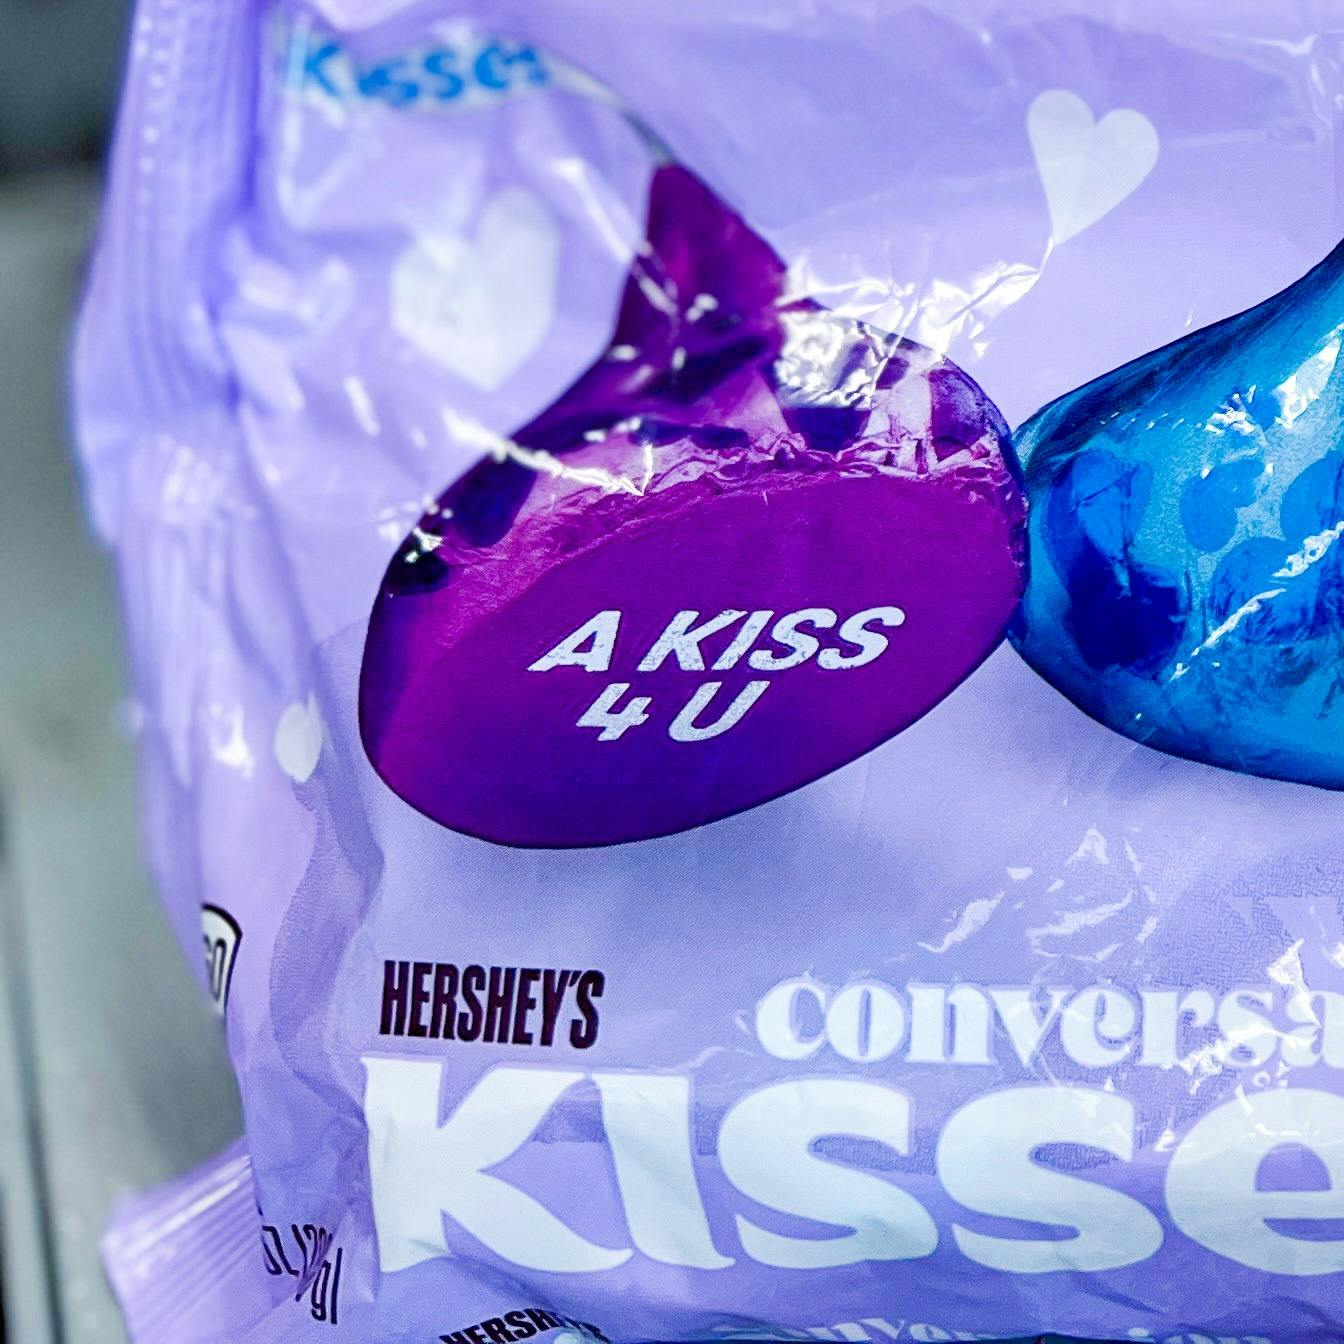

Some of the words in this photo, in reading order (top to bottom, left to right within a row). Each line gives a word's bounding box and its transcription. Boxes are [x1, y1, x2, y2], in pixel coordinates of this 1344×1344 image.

[527, 609, 622, 673] A
[637, 606, 905, 673] KISS
[576, 682, 653, 742] 4
[668, 680, 770, 743] U
[379, 959, 606, 1050] HERSHEY'S
